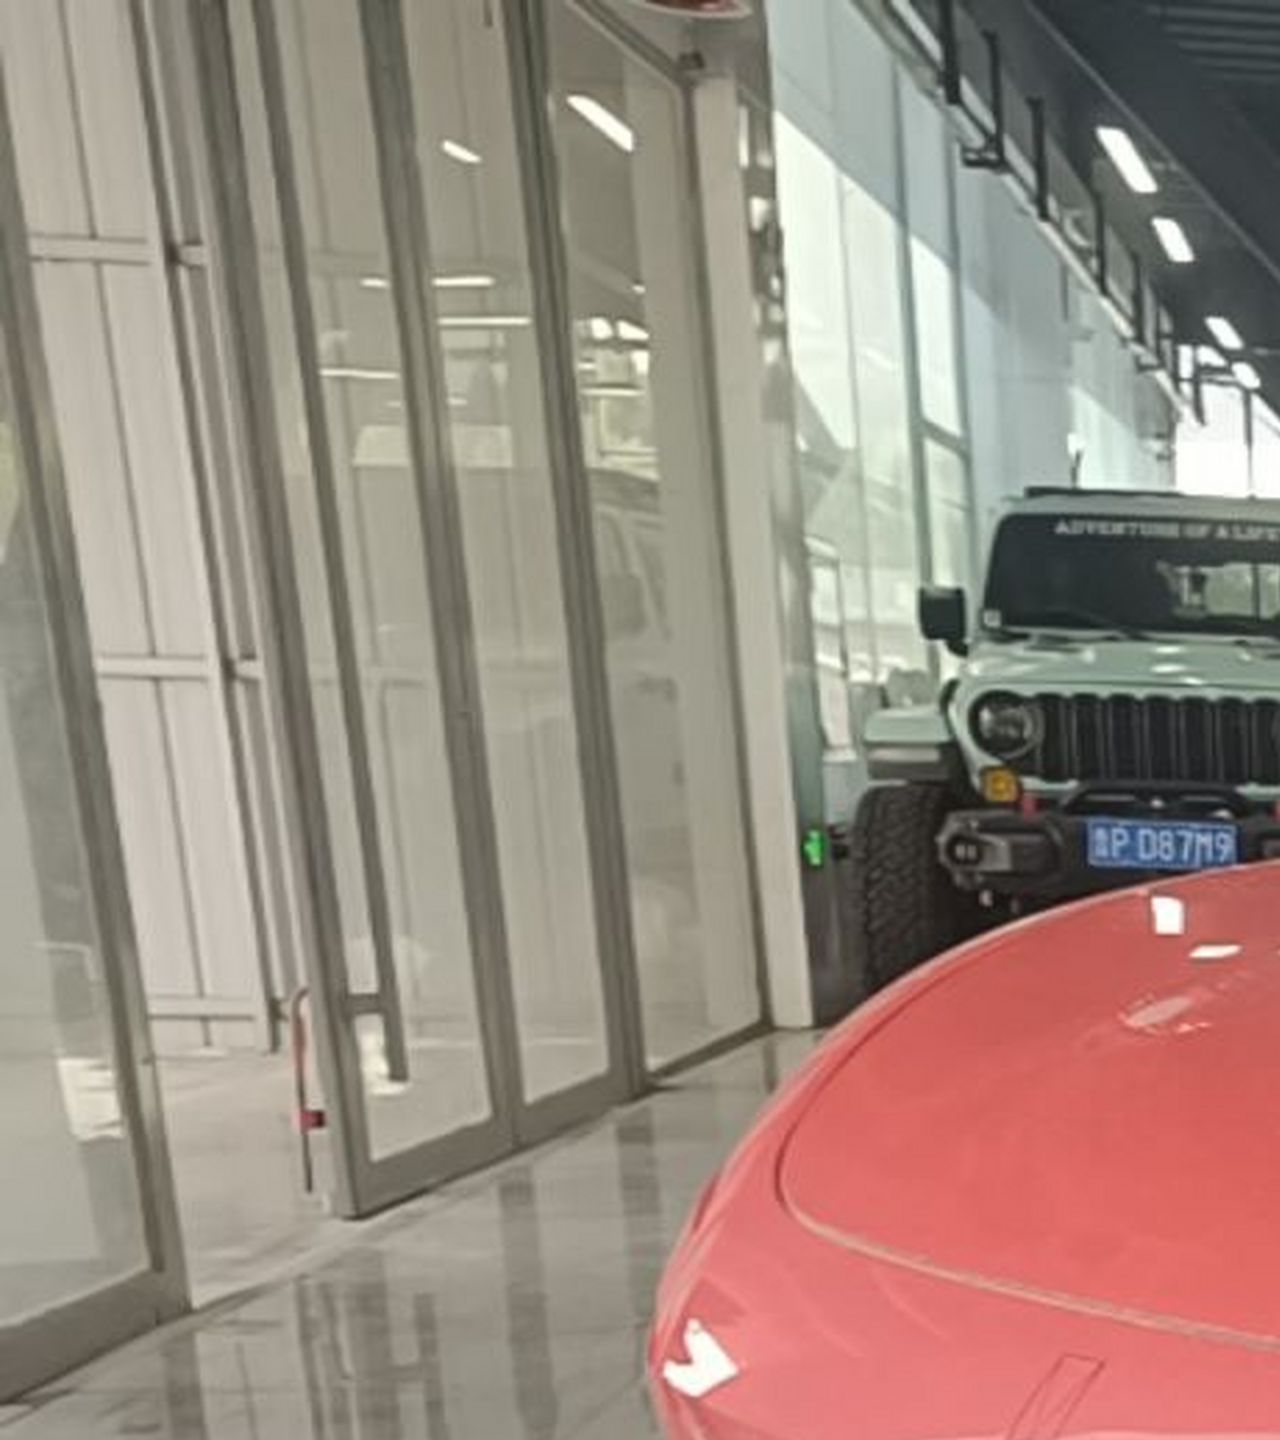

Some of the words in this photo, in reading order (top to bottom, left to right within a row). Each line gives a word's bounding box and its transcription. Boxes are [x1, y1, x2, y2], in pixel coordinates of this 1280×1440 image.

[1054, 518, 1180, 538] ADVENTURE
[1182, 523, 1210, 540] OF
[1214, 522, 1229, 540] A
